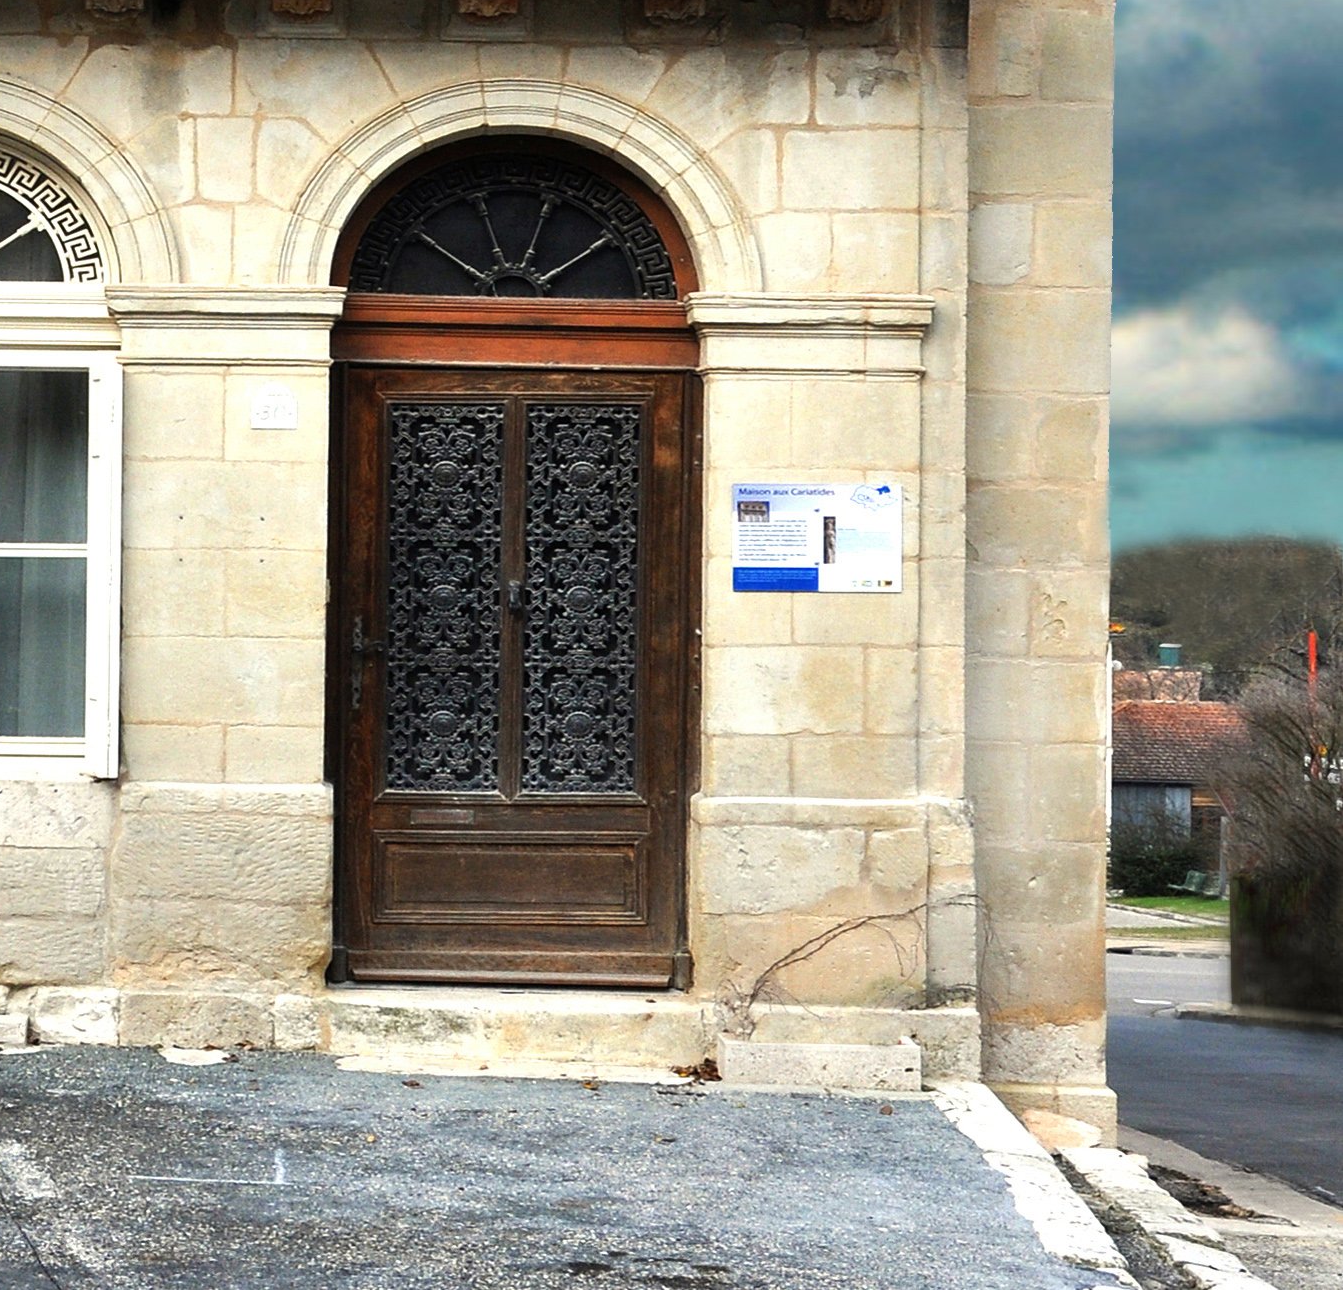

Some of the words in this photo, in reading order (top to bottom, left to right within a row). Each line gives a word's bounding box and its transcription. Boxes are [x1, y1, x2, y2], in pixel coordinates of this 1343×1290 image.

[738, 487, 771, 496] Maison
[772, 488, 789, 496] aux
[790, 487, 836, 496] Cariatides
